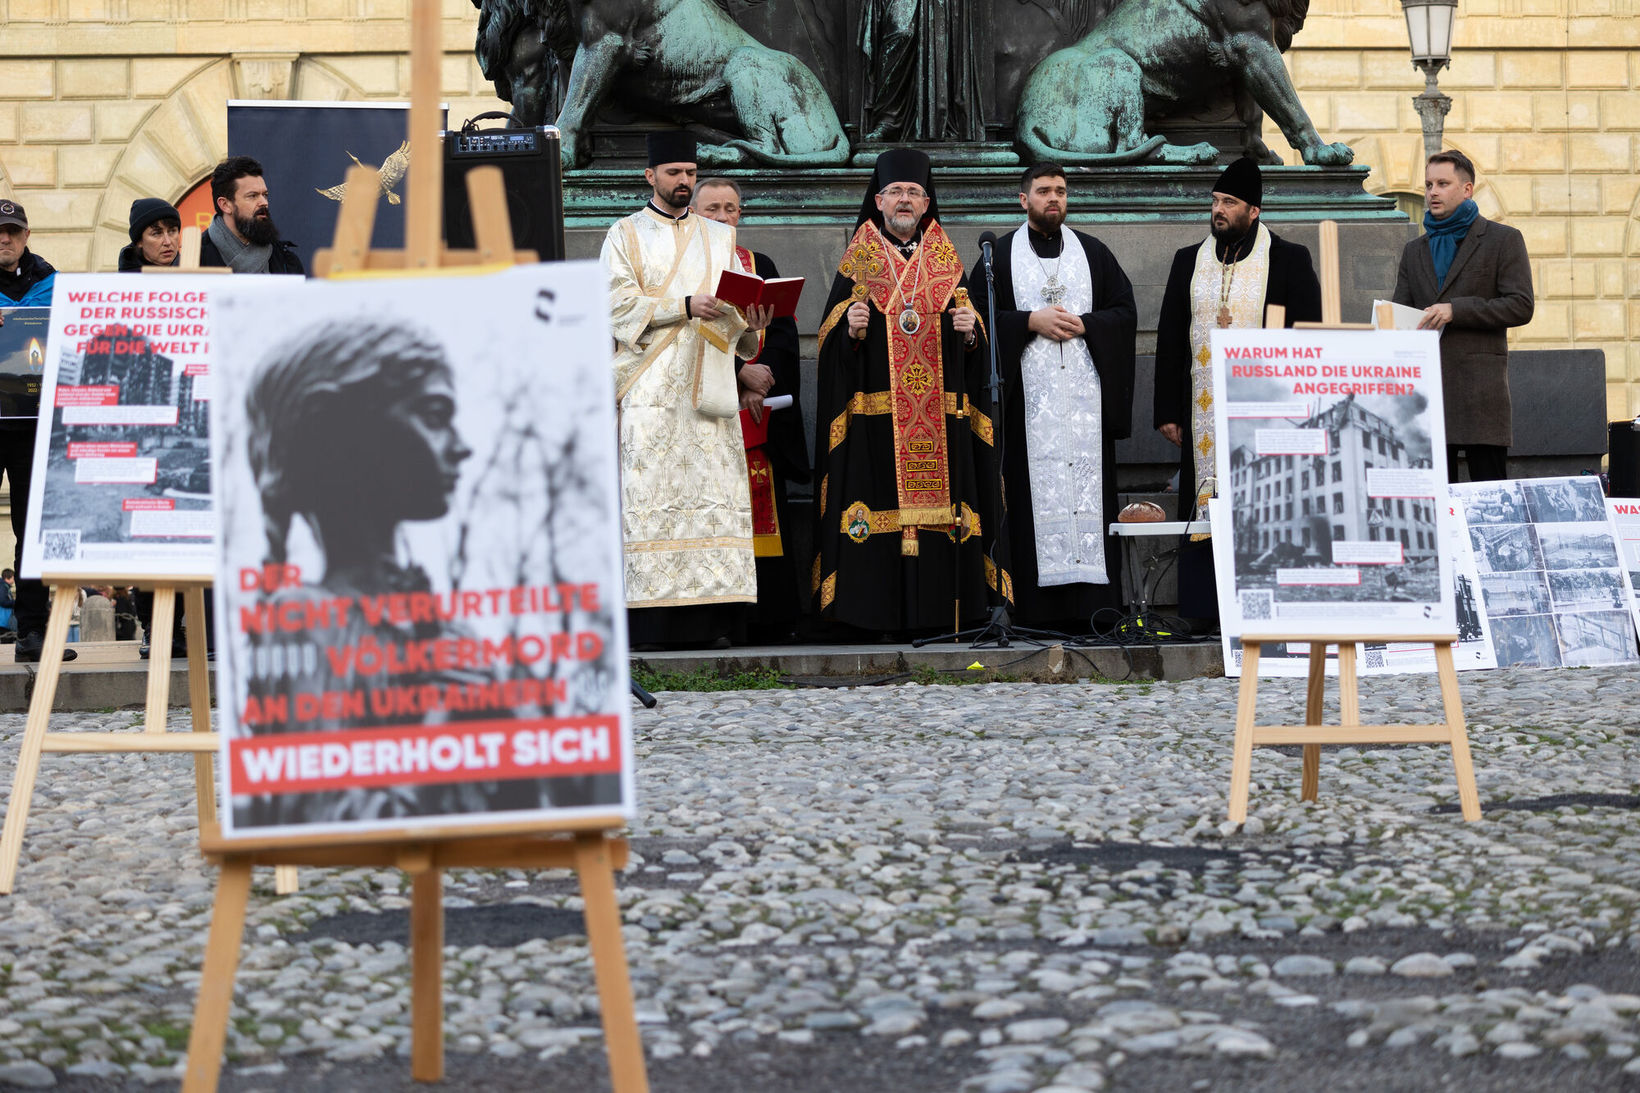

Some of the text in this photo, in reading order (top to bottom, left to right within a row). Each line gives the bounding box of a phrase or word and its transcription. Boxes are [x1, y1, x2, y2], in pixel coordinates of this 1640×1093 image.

[67, 291, 144, 303] WELCHE
[80, 306, 116, 319] DER
[63, 324, 128, 337] GEGEN
[131, 324, 162, 337] DIE
[76, 337, 112, 355] FÜR
[114, 341, 146, 355] DIE
[149, 341, 200, 354] WELT
[1224, 346, 1323, 360] WARUM HAT
[1231, 365, 1422, 379] RUSSLAND DIE UKRAINE
[1292, 382, 1416, 397] ANGEGRIFFEN?
[1613, 504, 1640, 515] WA
[239, 563, 303, 593] DER
[240, 583, 601, 634] NICHT VERURTEILTE
[326, 631, 604, 679] VÖLKERMORD
[240, 678, 567, 725] AN DEN UKRAINERN
[240, 726, 610, 783] WIEDERHOLT SICH
